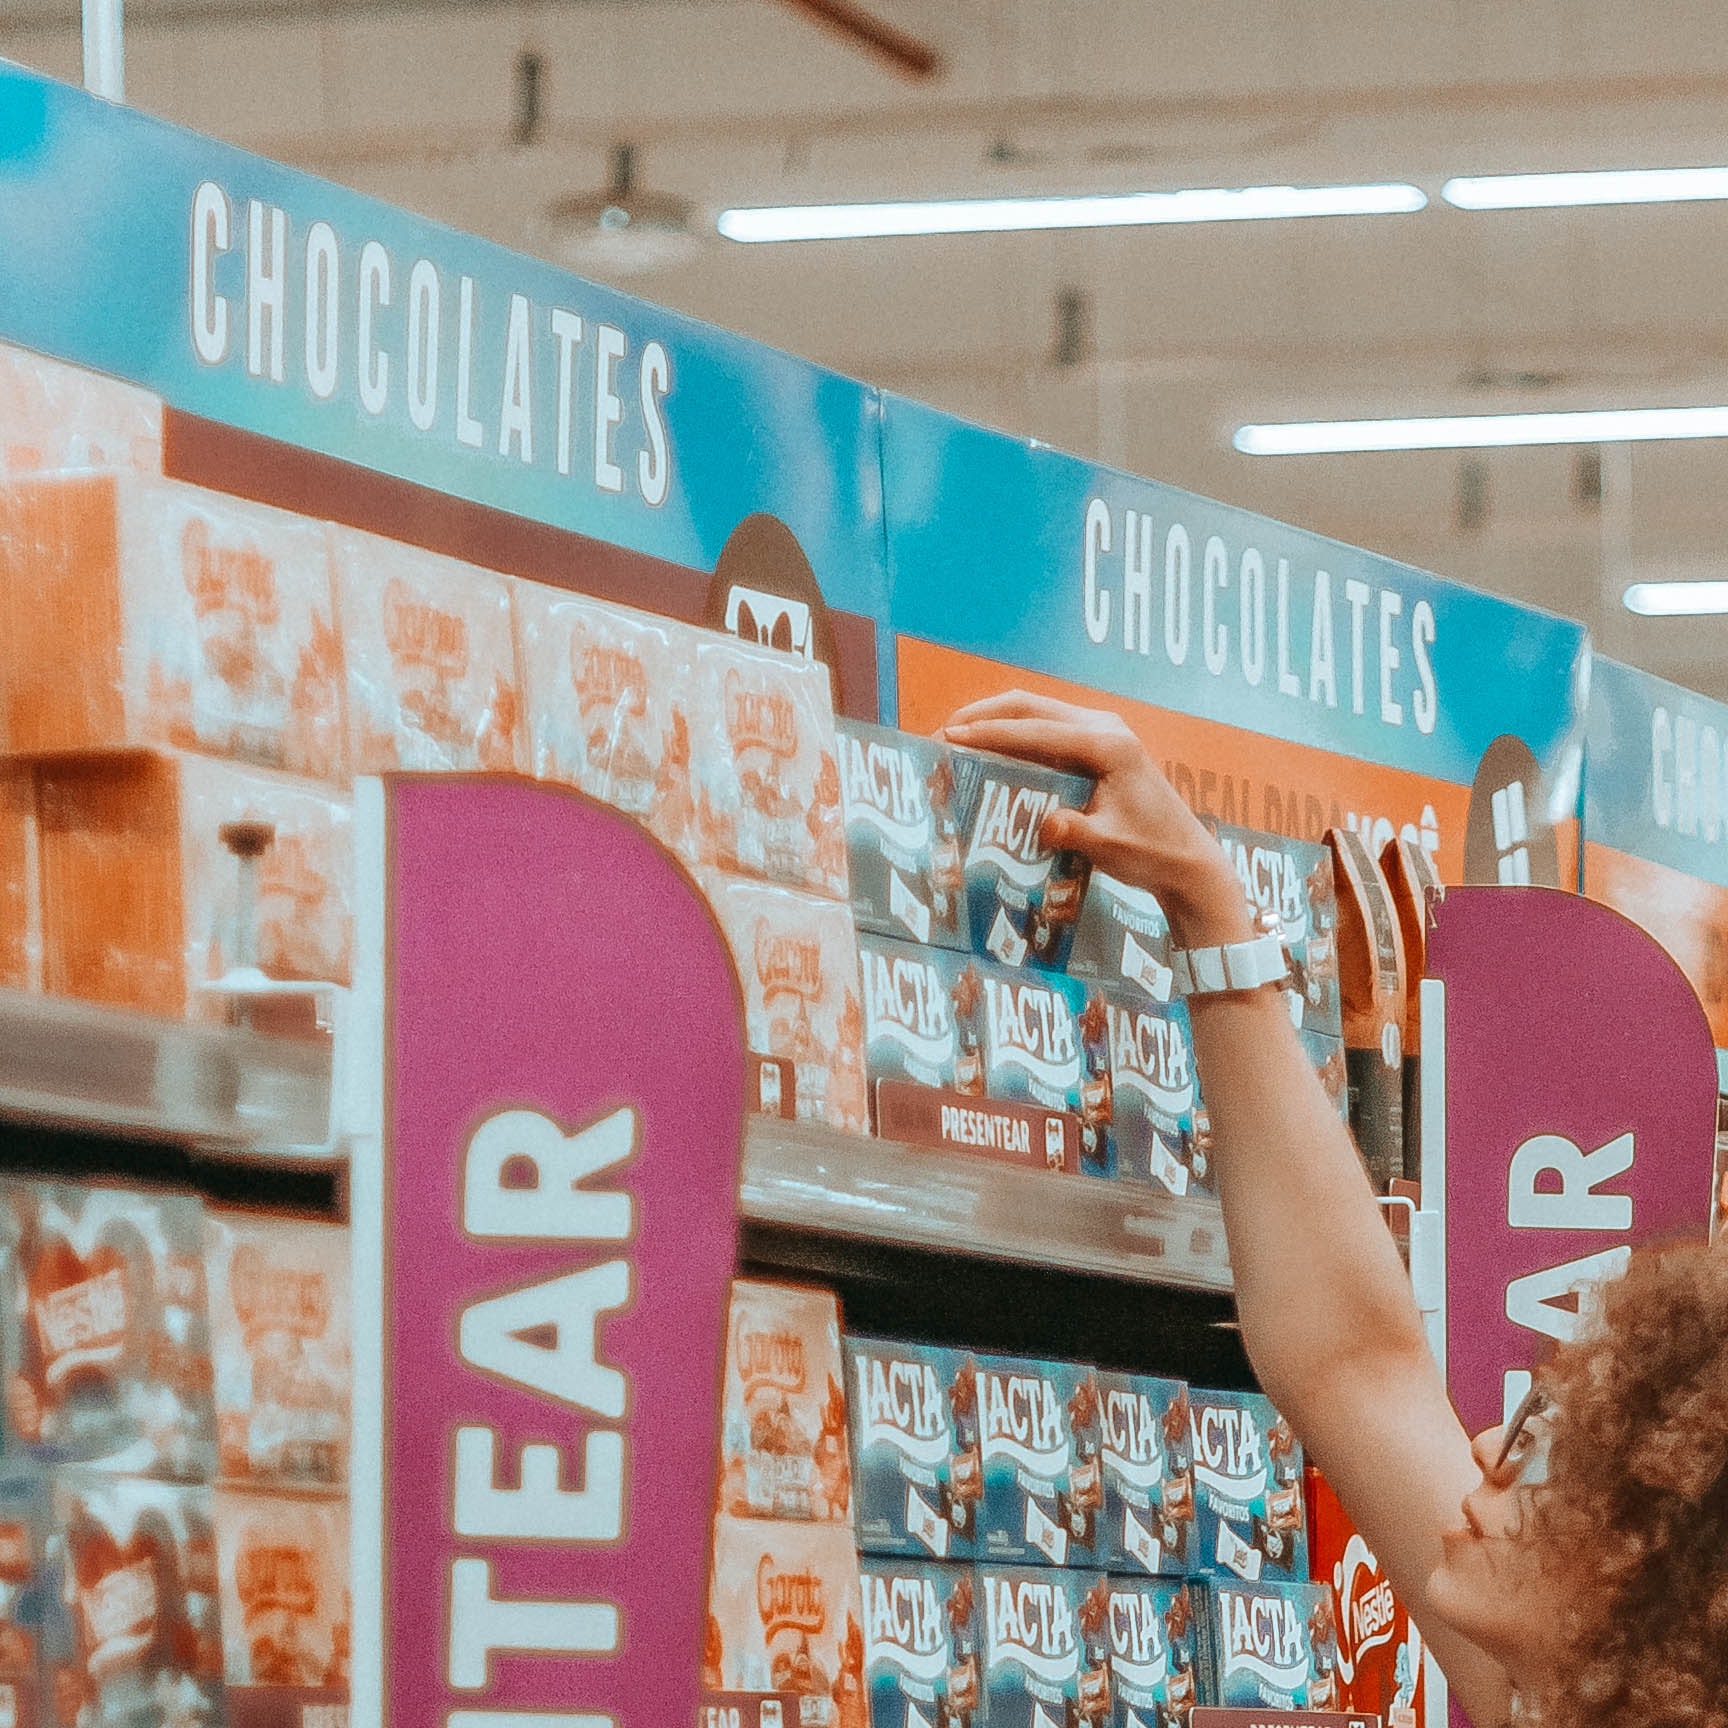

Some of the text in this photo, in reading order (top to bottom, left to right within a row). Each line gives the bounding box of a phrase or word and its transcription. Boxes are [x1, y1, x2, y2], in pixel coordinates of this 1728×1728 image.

[190, 180, 671, 506] CHOCOLATES
[1084, 497, 1437, 735] CHOCOLATES
[836, 732, 926, 828] LACTA
[1221, 839, 1303, 921] ACTA
[860, 950, 950, 1042] LACTA
[984, 978, 1079, 1068] LACTA
[1107, 1003, 1191, 1088] LACTA
[941, 1104, 1030, 1154] PRESENTEAR
[856, 1354, 947, 1448] LACTA
[975, 1371, 1066, 1458] LACTA
[1098, 1389, 1160, 1461] CTA
[861, 1574, 944, 1664] LACTA
[983, 1576, 1074, 1668] LACTA
[1108, 1592, 1162, 1662] CTA
[1218, 1590, 1304, 1674] LACTA
[1352, 1581, 1396, 1645] Nestlé
